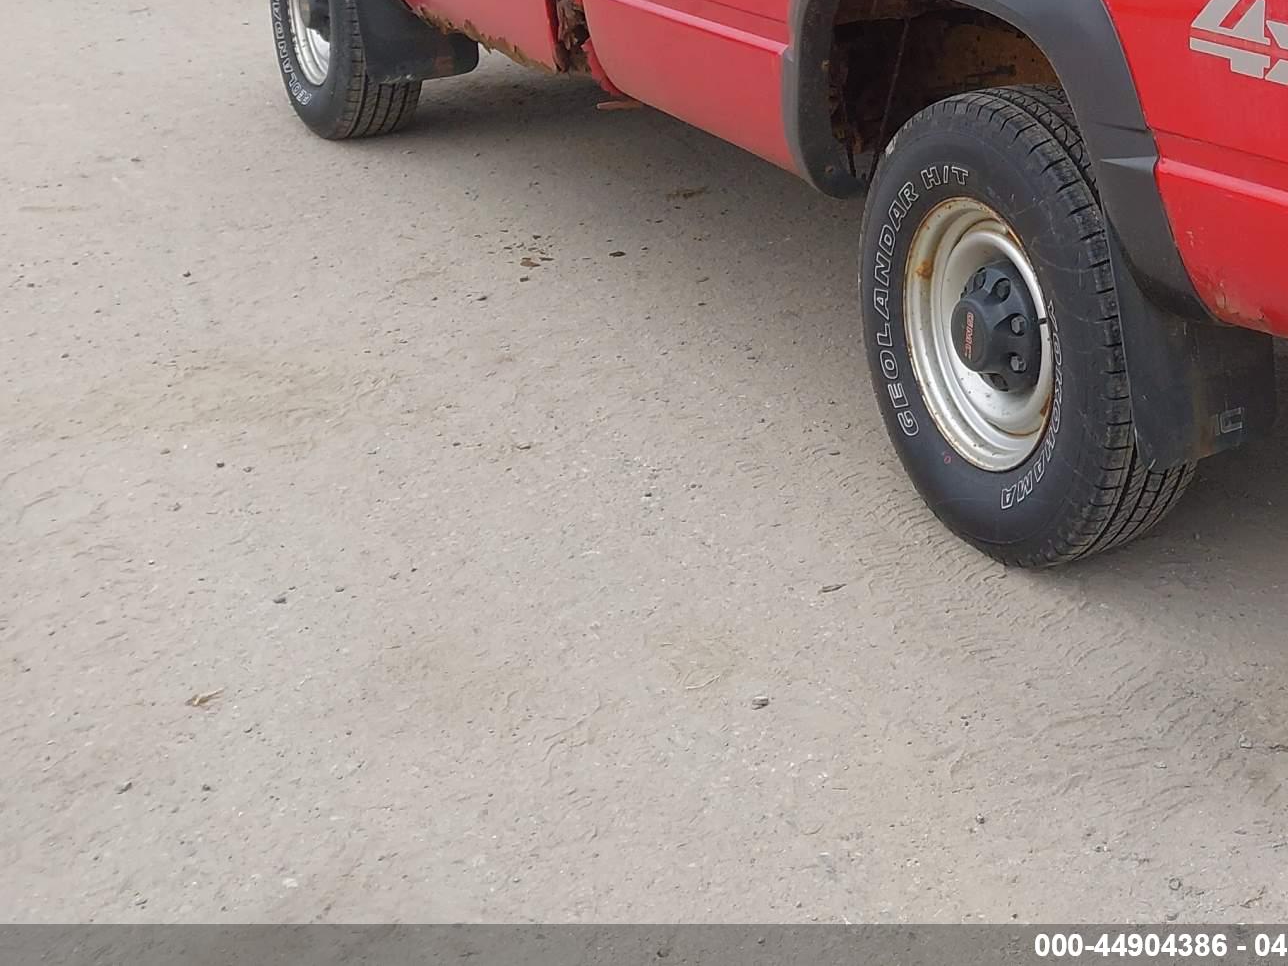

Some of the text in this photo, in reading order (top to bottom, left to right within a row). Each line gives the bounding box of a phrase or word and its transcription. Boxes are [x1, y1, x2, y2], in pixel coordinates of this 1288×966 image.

[873, 165, 970, 437] GEOLANDAR H/T
[965, 311, 975, 360] GMC
[1000, 299, 1064, 510] YOKOHAMA
